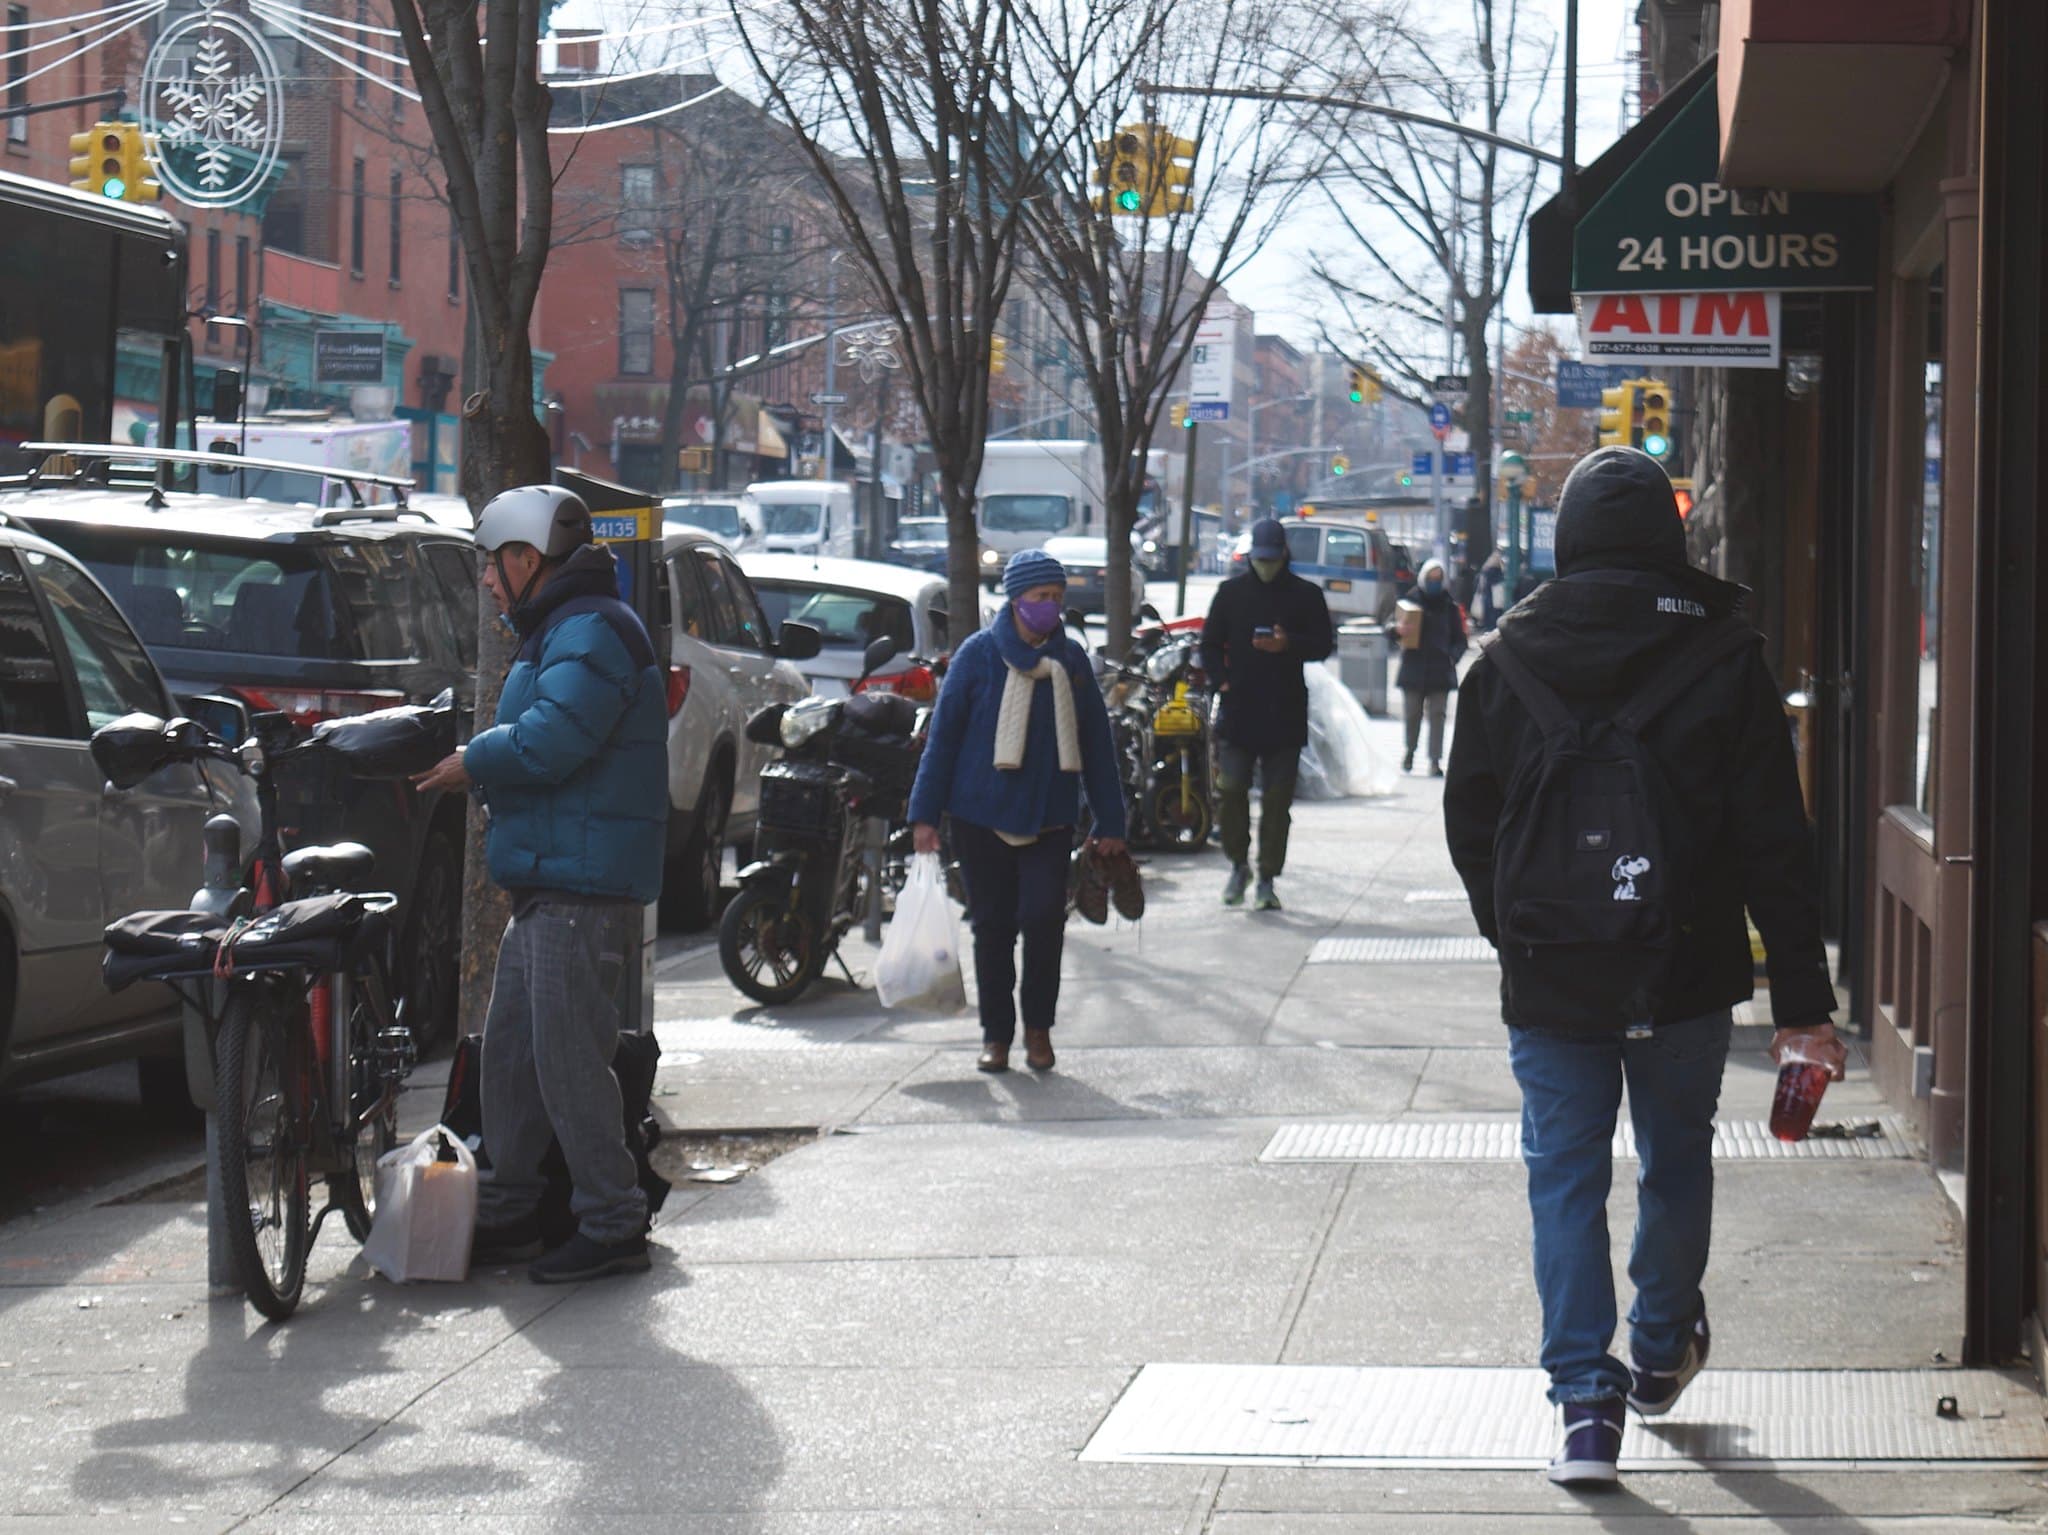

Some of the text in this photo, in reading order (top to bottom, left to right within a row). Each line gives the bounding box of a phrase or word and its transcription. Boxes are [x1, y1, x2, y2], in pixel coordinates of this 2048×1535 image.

[1616, 232, 1840, 272] 24 HOURS
[1589, 294, 1770, 337] ATM
